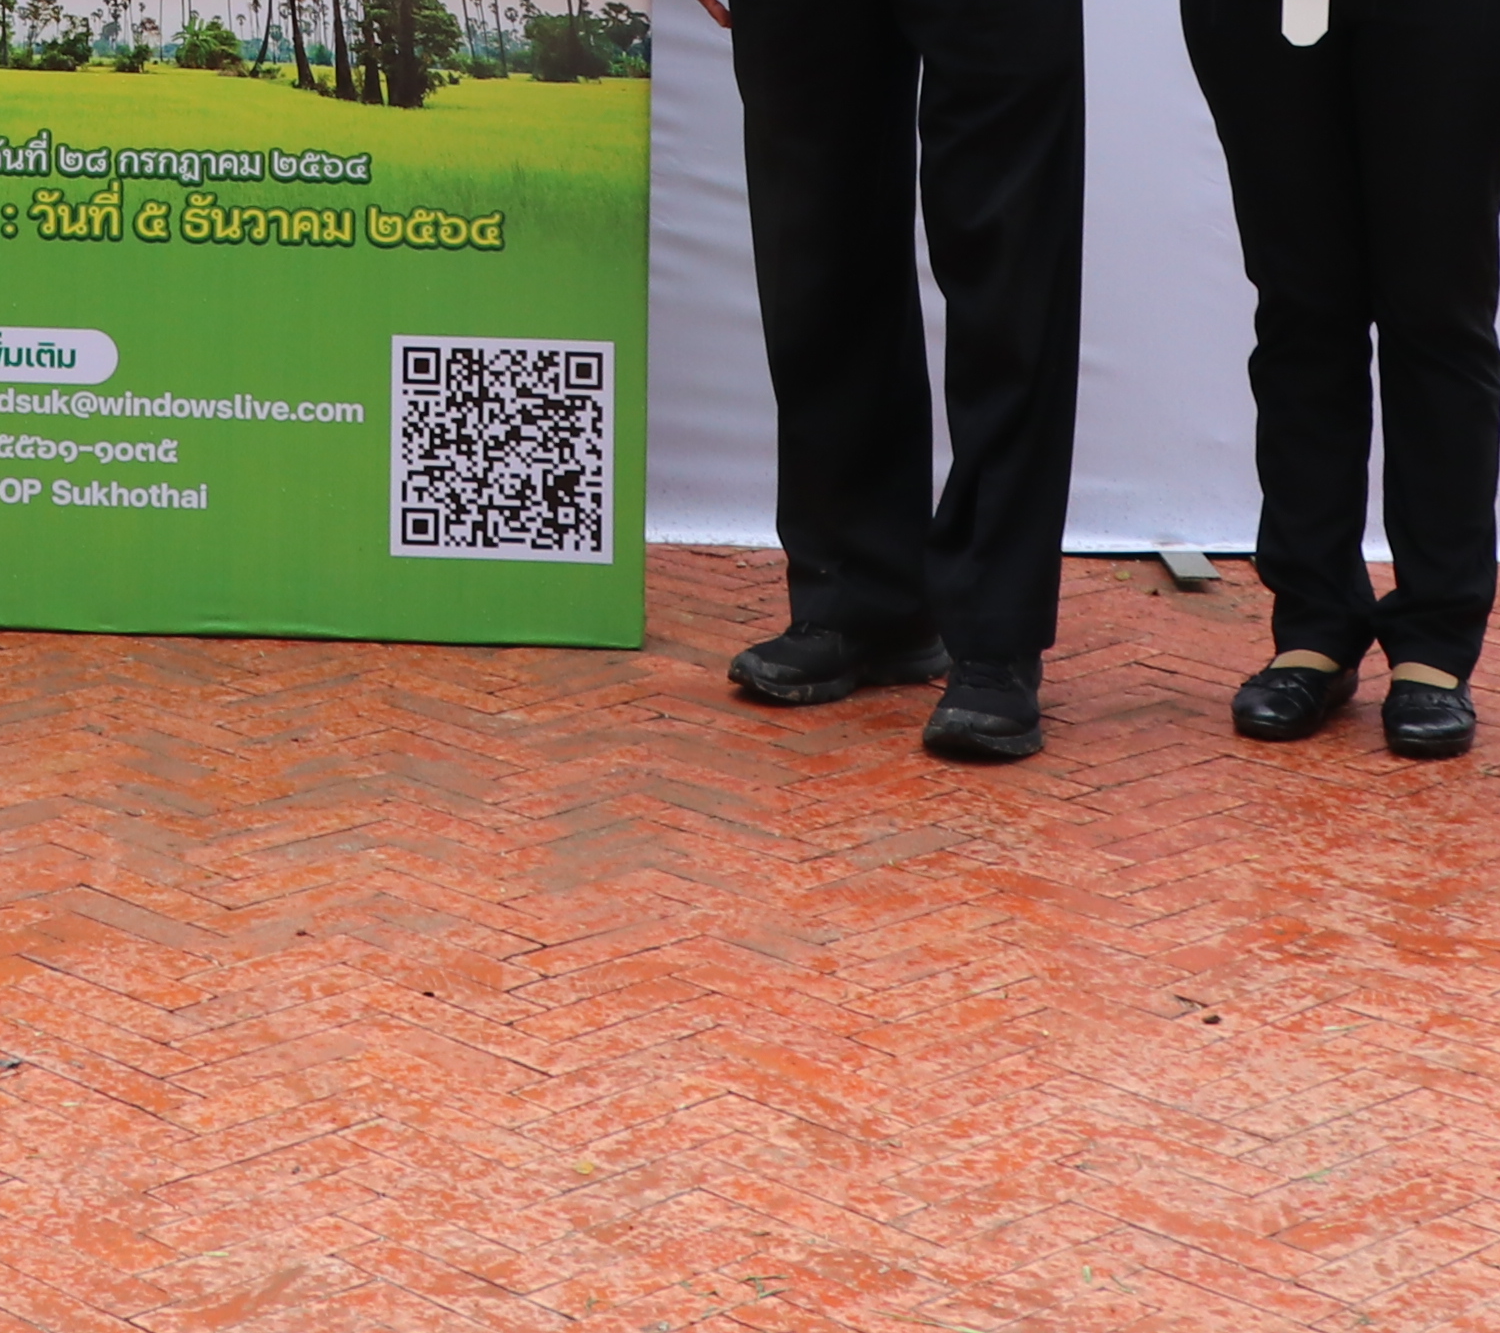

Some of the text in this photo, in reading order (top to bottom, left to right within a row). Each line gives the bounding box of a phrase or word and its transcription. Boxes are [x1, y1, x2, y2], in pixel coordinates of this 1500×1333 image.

[57, 146, 109, 176] ๒๘
[118, 148, 263, 186] กรกฎาคม
[272, 148, 371, 181] ๒๕๖๔
[29, 183, 122, 239] วันที่
[135, 199, 170, 239] ๕
[183, 194, 353, 243] ธันวาคม
[366, 204, 505, 249] ๒๕๖๔
[52, 480, 207, 509] Sukhothai
